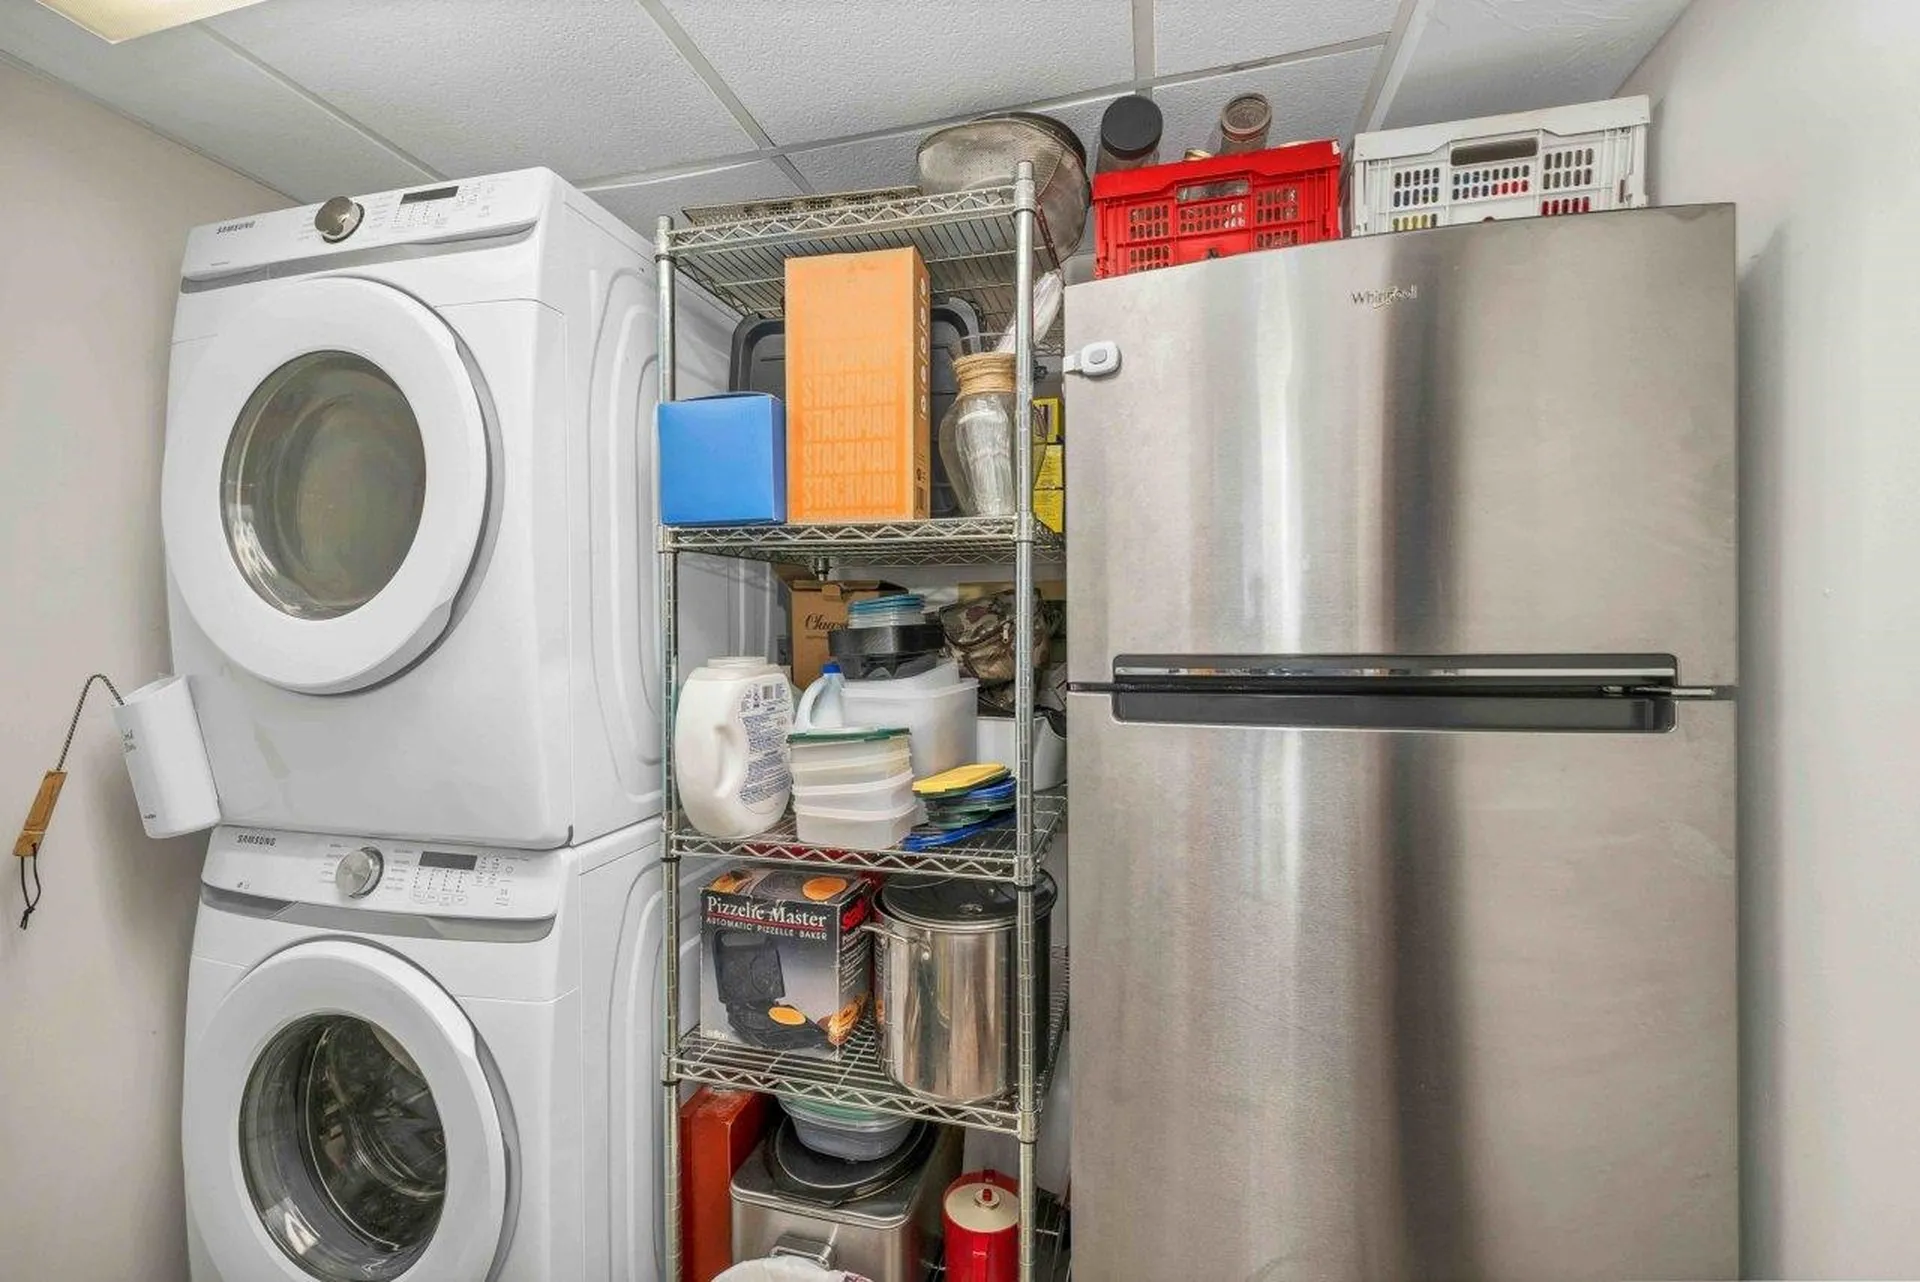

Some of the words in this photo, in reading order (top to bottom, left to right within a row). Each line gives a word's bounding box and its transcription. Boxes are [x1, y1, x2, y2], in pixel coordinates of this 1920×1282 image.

[236, 834, 277, 847] SAMSUNG
[769, 902, 828, 928] Master
[706, 917, 753, 931] AUTOMATIC
[757, 923, 794, 938] PIZZELLE
[799, 931, 828, 941] BAKER
